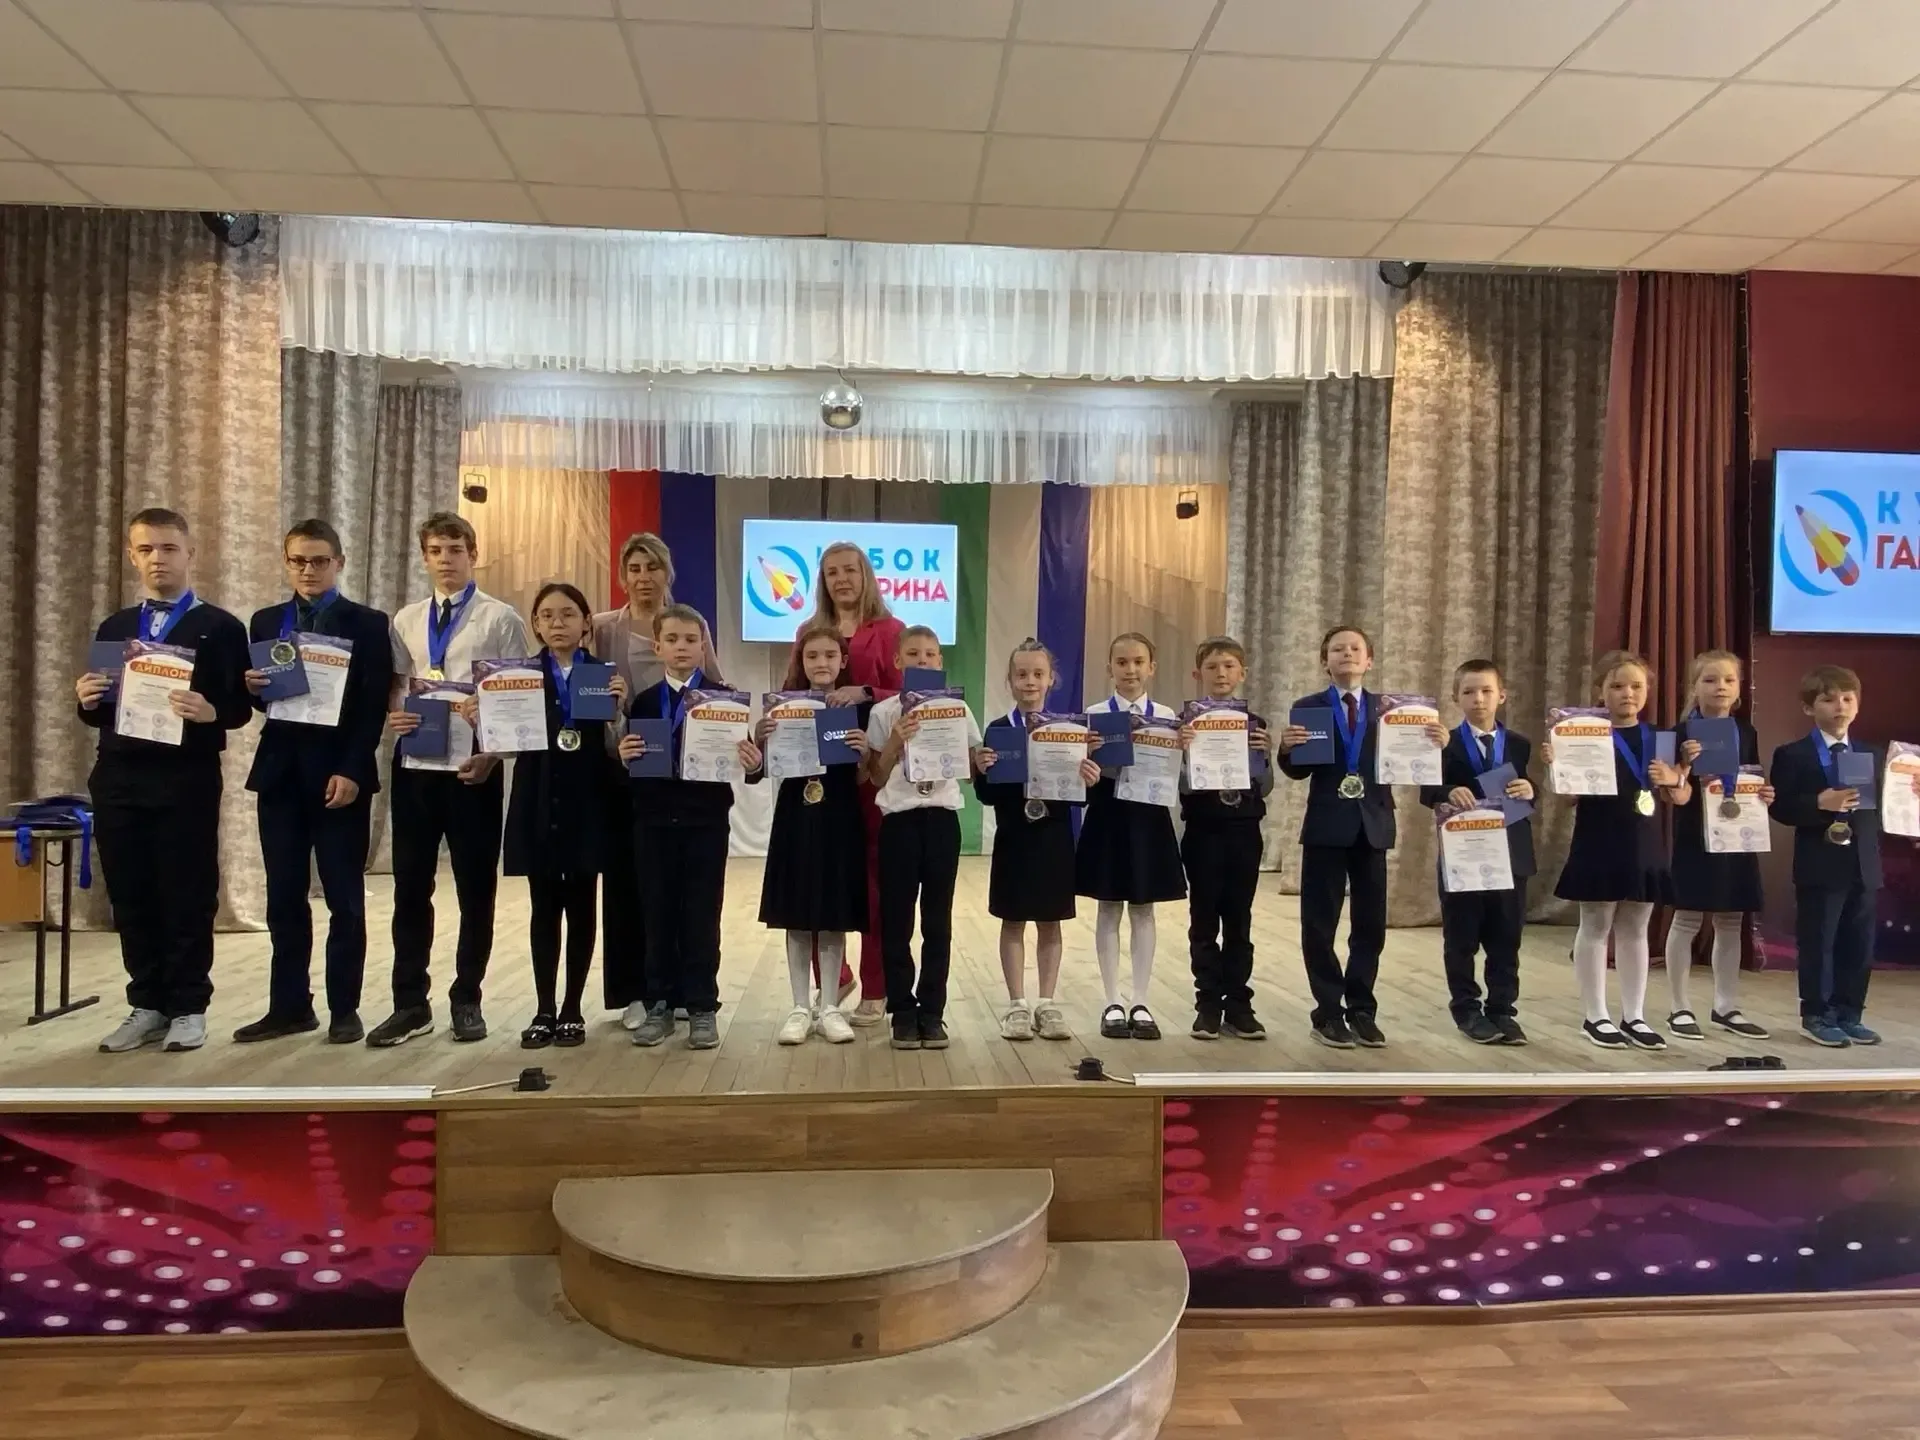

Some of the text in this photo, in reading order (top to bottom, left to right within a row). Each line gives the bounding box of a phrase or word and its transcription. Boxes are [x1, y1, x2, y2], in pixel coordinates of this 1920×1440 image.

[1878, 491, 1920, 525] К
[1876, 535, 1920, 570] ГА
[876, 577, 950, 603] РИНА
[302, 652, 347, 667] ИПЛОМ
[135, 663, 190, 680] ДИПЛОМ
[488, 680, 541, 690] ДИПЛОМ
[696, 710, 747, 722] ДИПЛОМ
[776, 709, 815, 718] ДИПЛО
[916, 708, 964, 720] ДИПЛОМ
[1198, 720, 1245, 730] ДИПЛОМ
[1037, 732, 1085, 742] ДИПЛОМ
[1560, 727, 1609, 736] ДИПЛОМ
[1451, 820, 1503, 830] ДИПЛОМ
